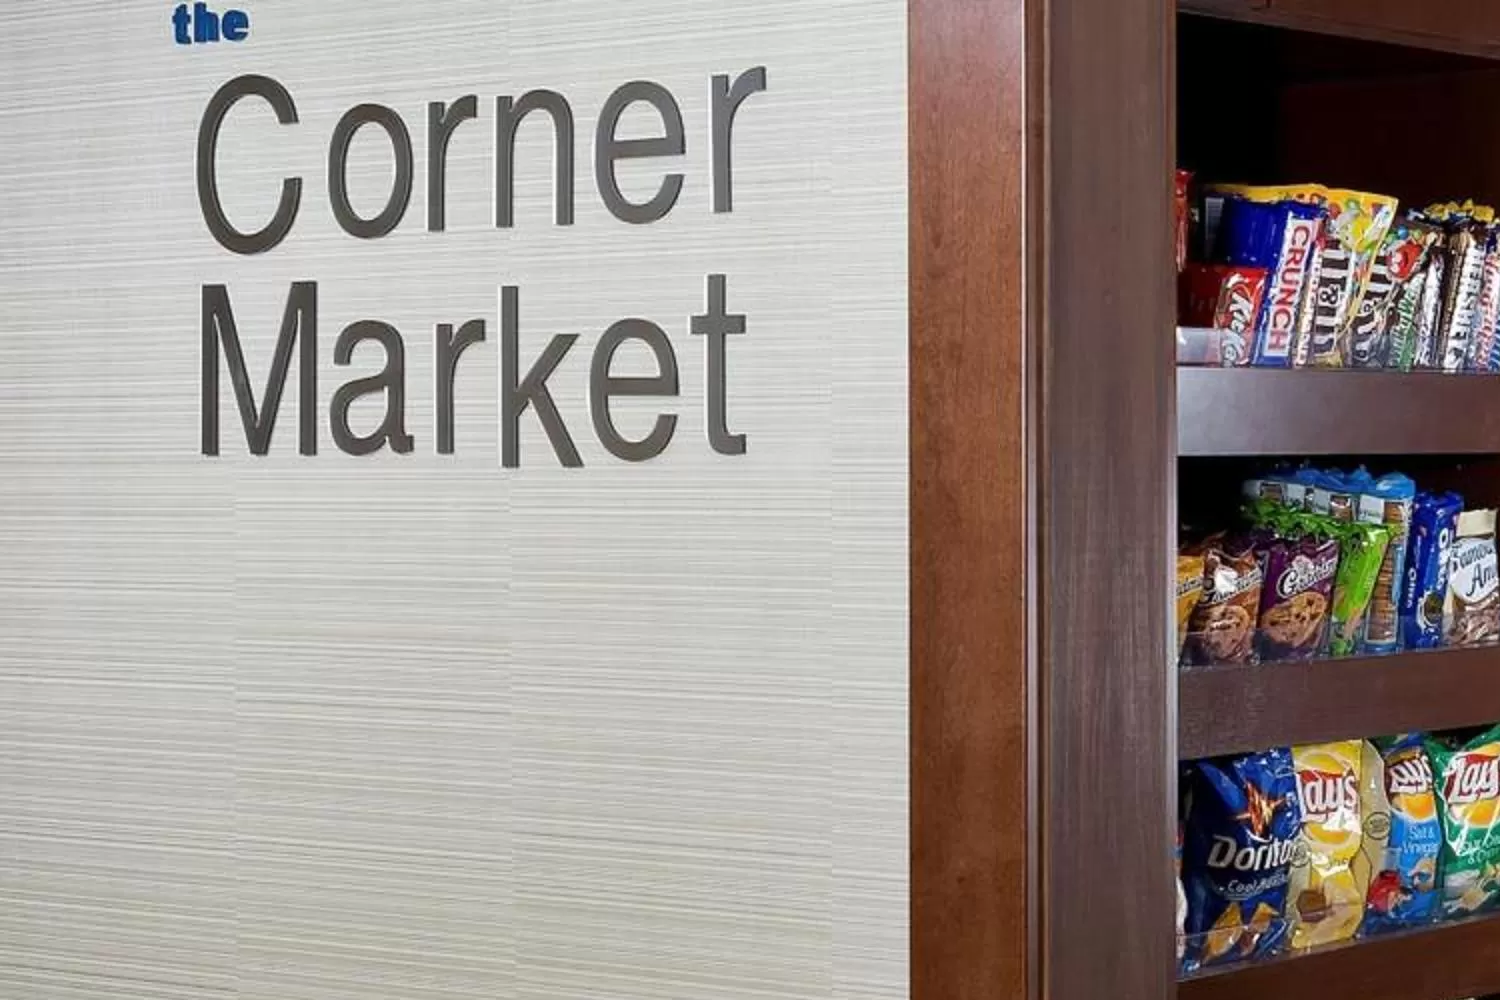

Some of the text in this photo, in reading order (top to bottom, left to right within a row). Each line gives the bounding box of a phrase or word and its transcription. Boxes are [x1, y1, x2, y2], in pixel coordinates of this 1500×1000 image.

[172, 2, 250, 45] the
[196, 65, 767, 255] Corner
[1267, 223, 1311, 350] CRUNCH
[201, 274, 747, 468] Market
